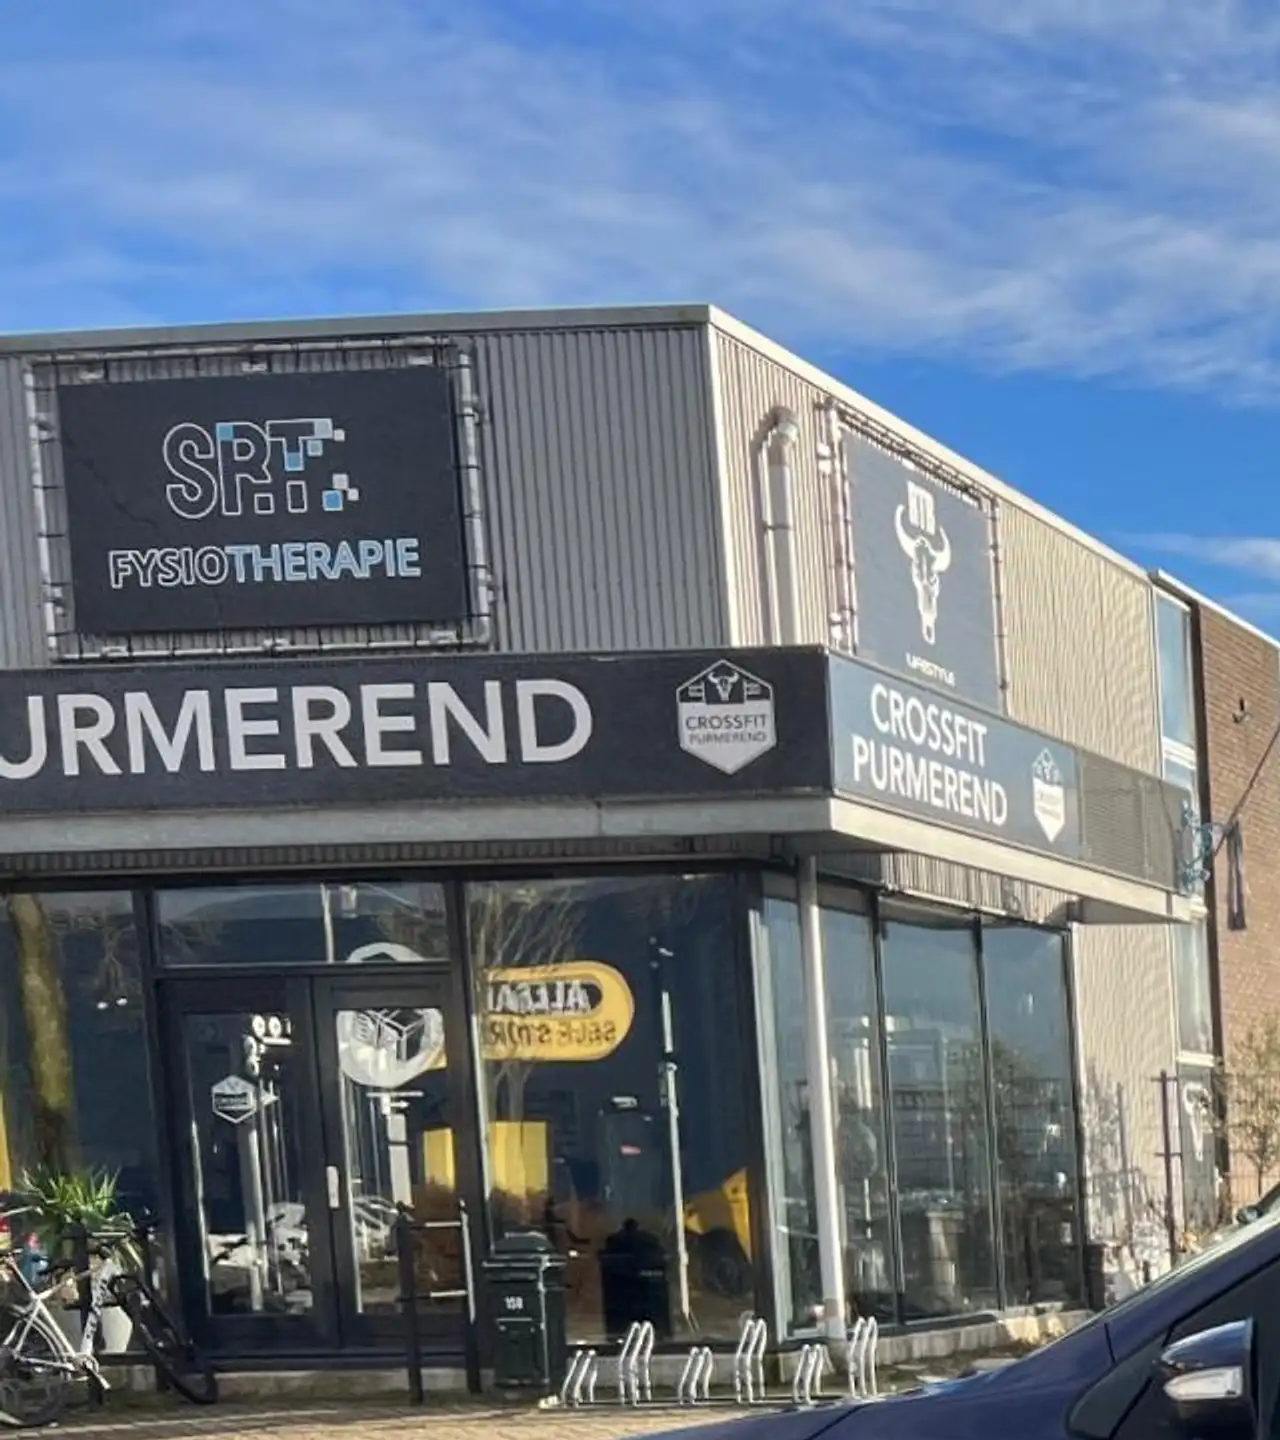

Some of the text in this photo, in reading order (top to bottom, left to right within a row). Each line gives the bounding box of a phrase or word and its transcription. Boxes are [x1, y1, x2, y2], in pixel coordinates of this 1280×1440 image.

[163, 418, 334, 519] SRT
[109, 538, 421, 588] FYSIOTHERAPIE
[685, 714, 768, 730] CROSSFIT
[870, 683, 988, 768] CROSSFIT
[851, 733, 1008, 826] PURMEREND
